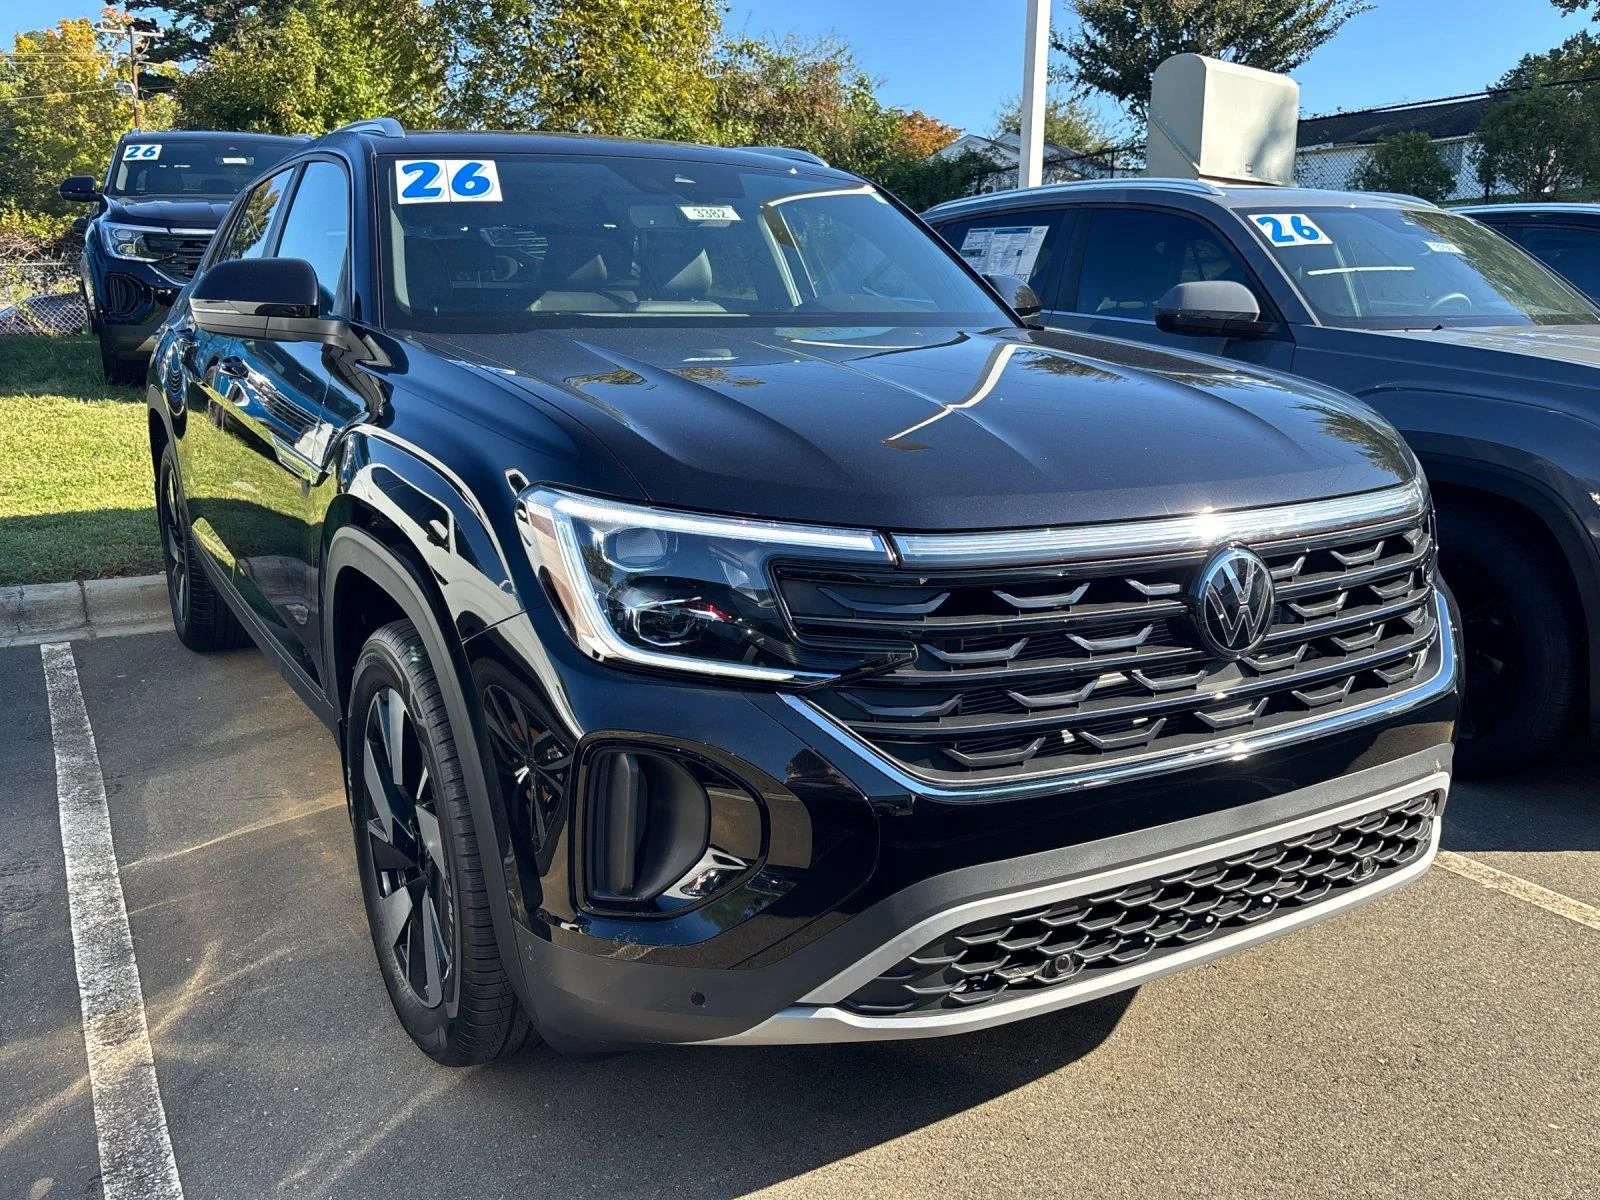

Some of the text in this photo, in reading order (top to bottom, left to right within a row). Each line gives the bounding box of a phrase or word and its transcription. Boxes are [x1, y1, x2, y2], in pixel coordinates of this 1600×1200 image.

[125, 145, 156, 159] 26
[401, 161, 492, 199] 26
[693, 208, 730, 219] 3382
[1256, 215, 1321, 243] 26
